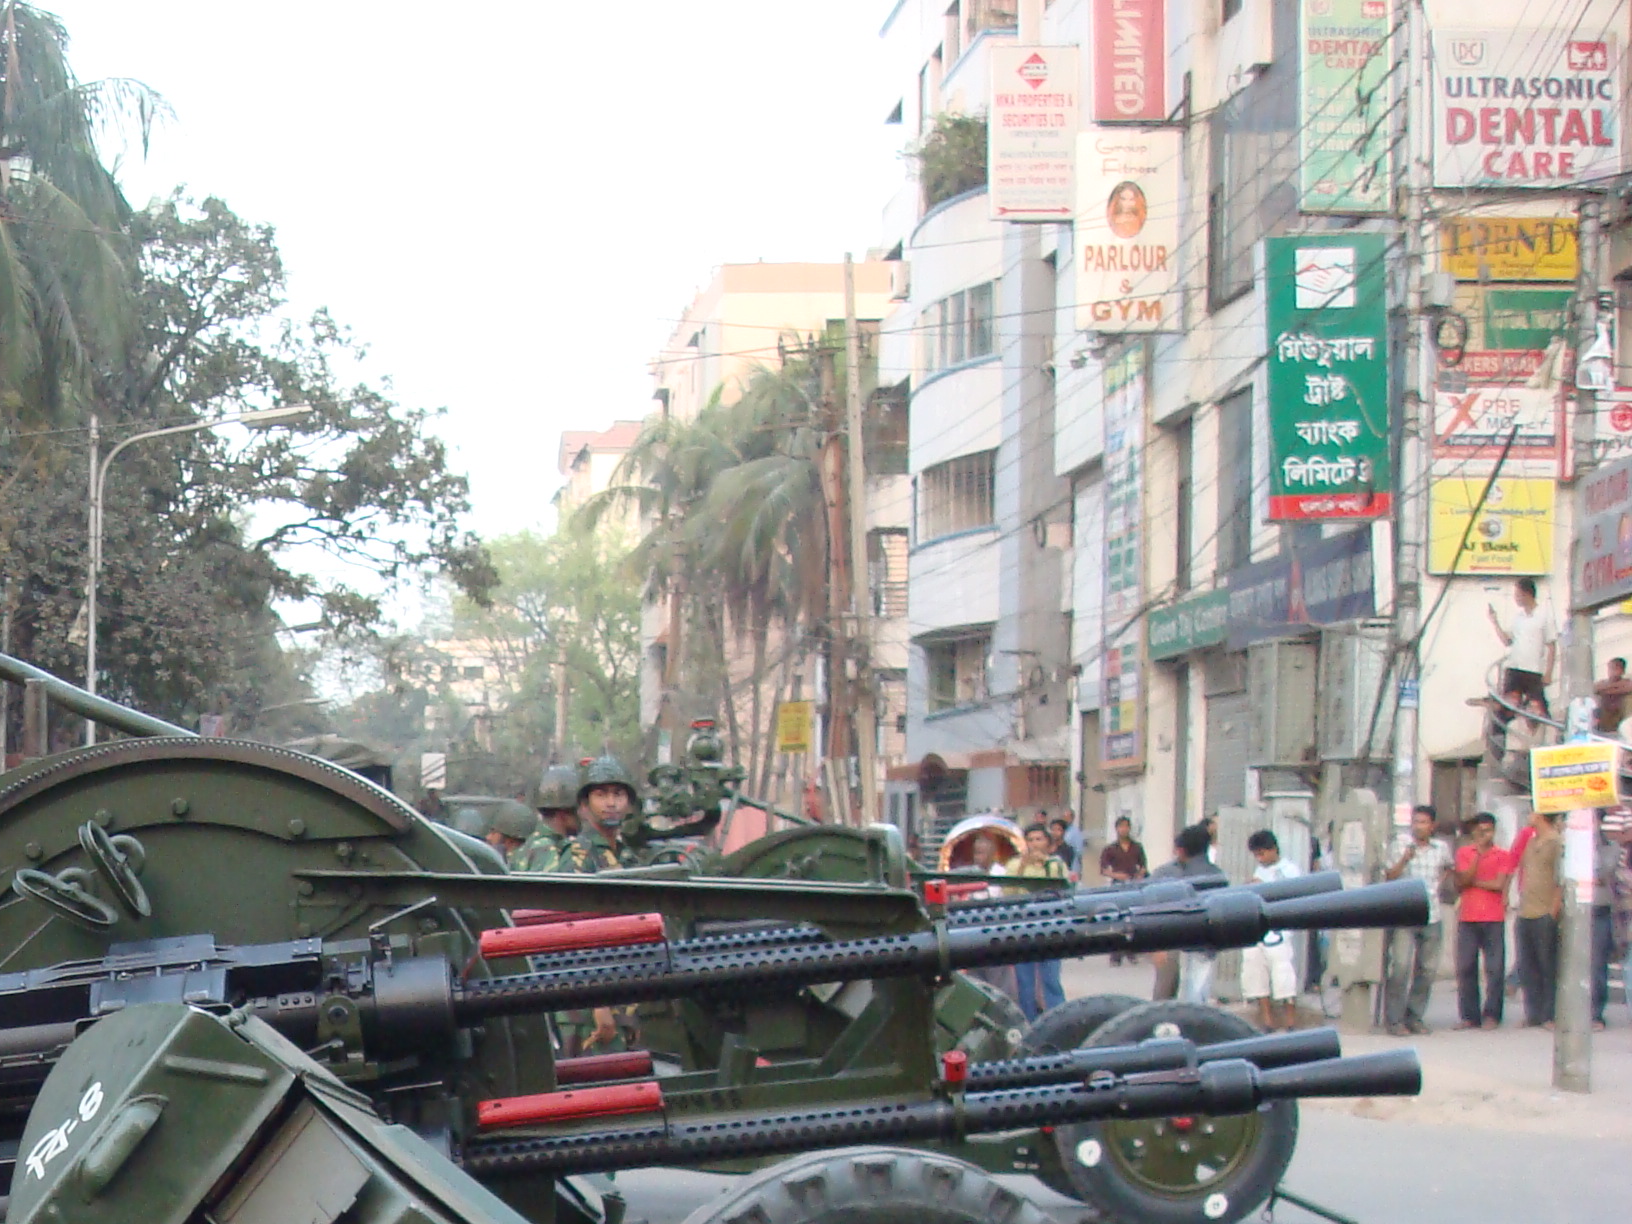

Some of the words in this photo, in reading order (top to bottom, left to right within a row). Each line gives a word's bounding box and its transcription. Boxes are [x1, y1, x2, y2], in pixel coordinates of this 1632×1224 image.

[1307, 39, 1383, 56] DENTAL
[1445, 76, 1613, 101] ULTRASONIC
[1446, 107, 1614, 147] DENTAL
[1095, 138, 1148, 155] Group
[1482, 151, 1575, 179] CARE
[1084, 245, 1168, 273] PARLOUR
[1119, 279, 1133, 294] &
[1090, 300, 1164, 322] GYM
[1276, 332, 1374, 368] মিউচুয়াল
[1295, 420, 1361, 446] ব্যাংক
